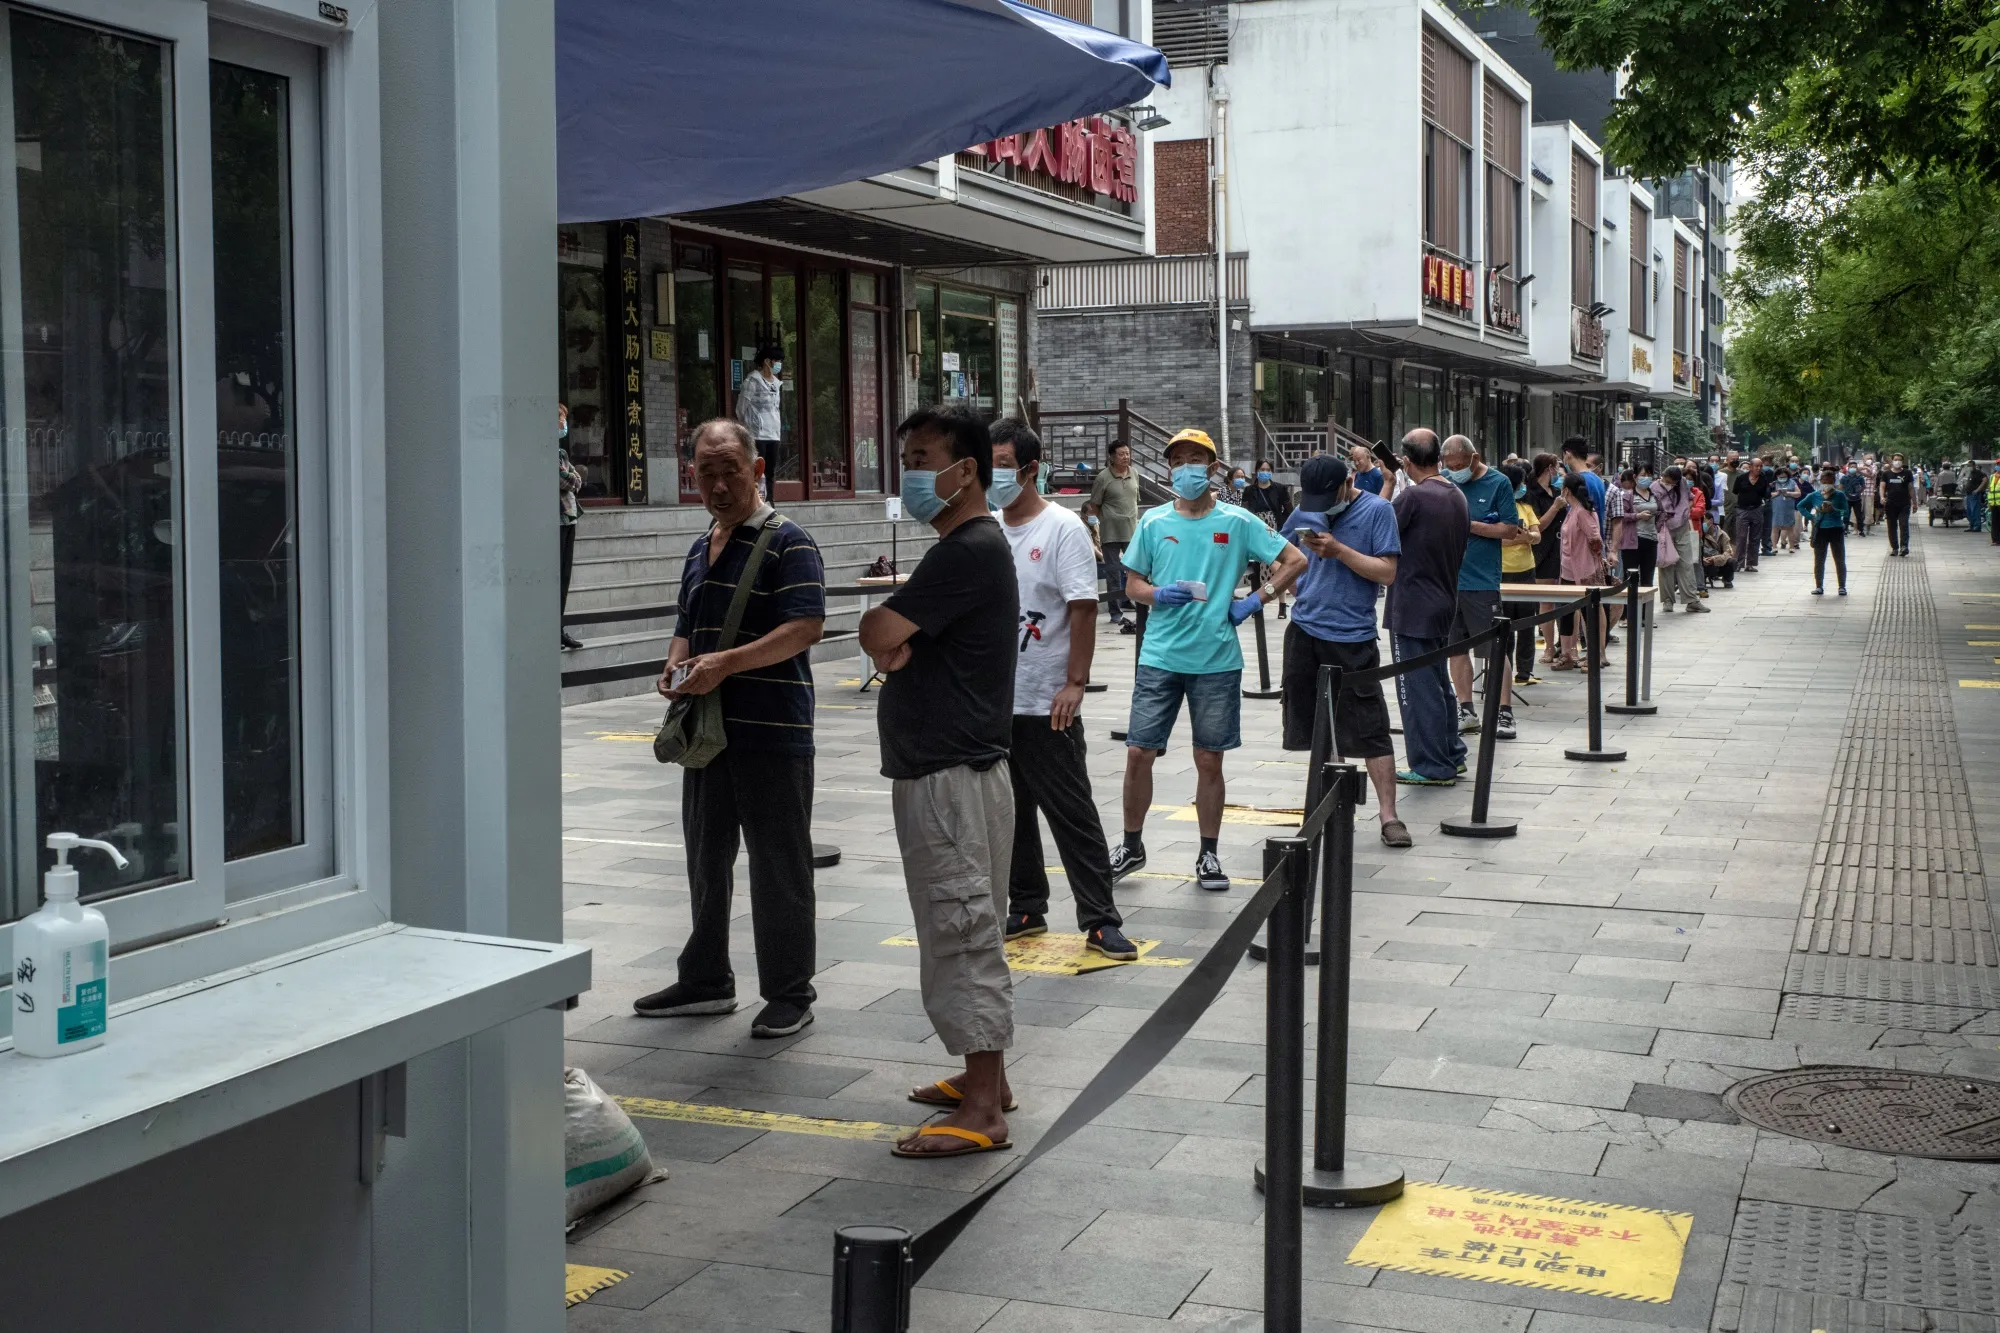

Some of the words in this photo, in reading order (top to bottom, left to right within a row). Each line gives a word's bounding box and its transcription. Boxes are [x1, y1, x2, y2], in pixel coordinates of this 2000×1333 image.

[965, 116, 1138, 204] 大肠卤煮
[1472, 1195, 1609, 1219] 请保持2米距离
[1427, 1206, 1642, 1243] 不在室内充电
[1472, 1223, 1581, 1247] 蓄电池
[1418, 1246, 1608, 1279] 电动自行车
[1462, 1240, 1576, 1261] 不上楼
